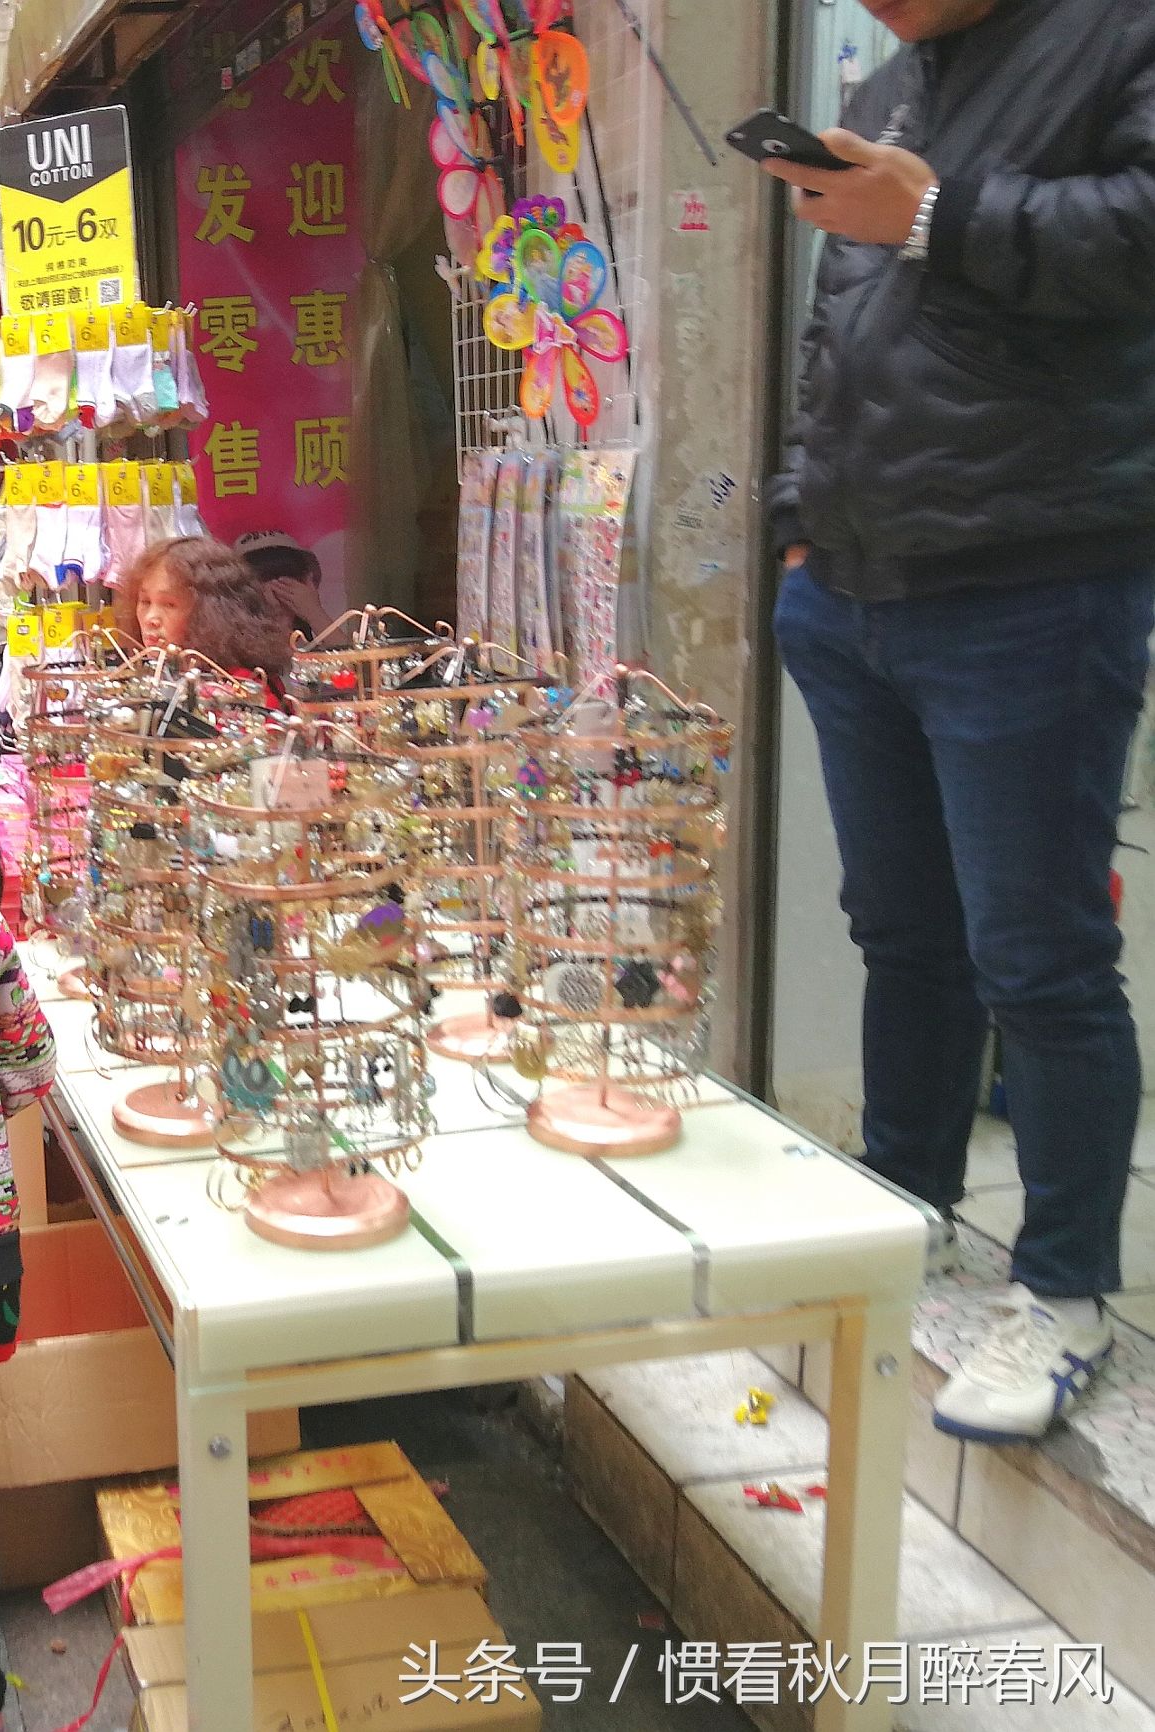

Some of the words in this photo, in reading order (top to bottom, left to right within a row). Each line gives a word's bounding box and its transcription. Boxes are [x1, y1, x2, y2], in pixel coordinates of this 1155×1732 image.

[27, 124, 92, 171] UNI
[30, 162, 94, 187] COTTON
[282, 38, 348, 488] 欢迎惠顾
